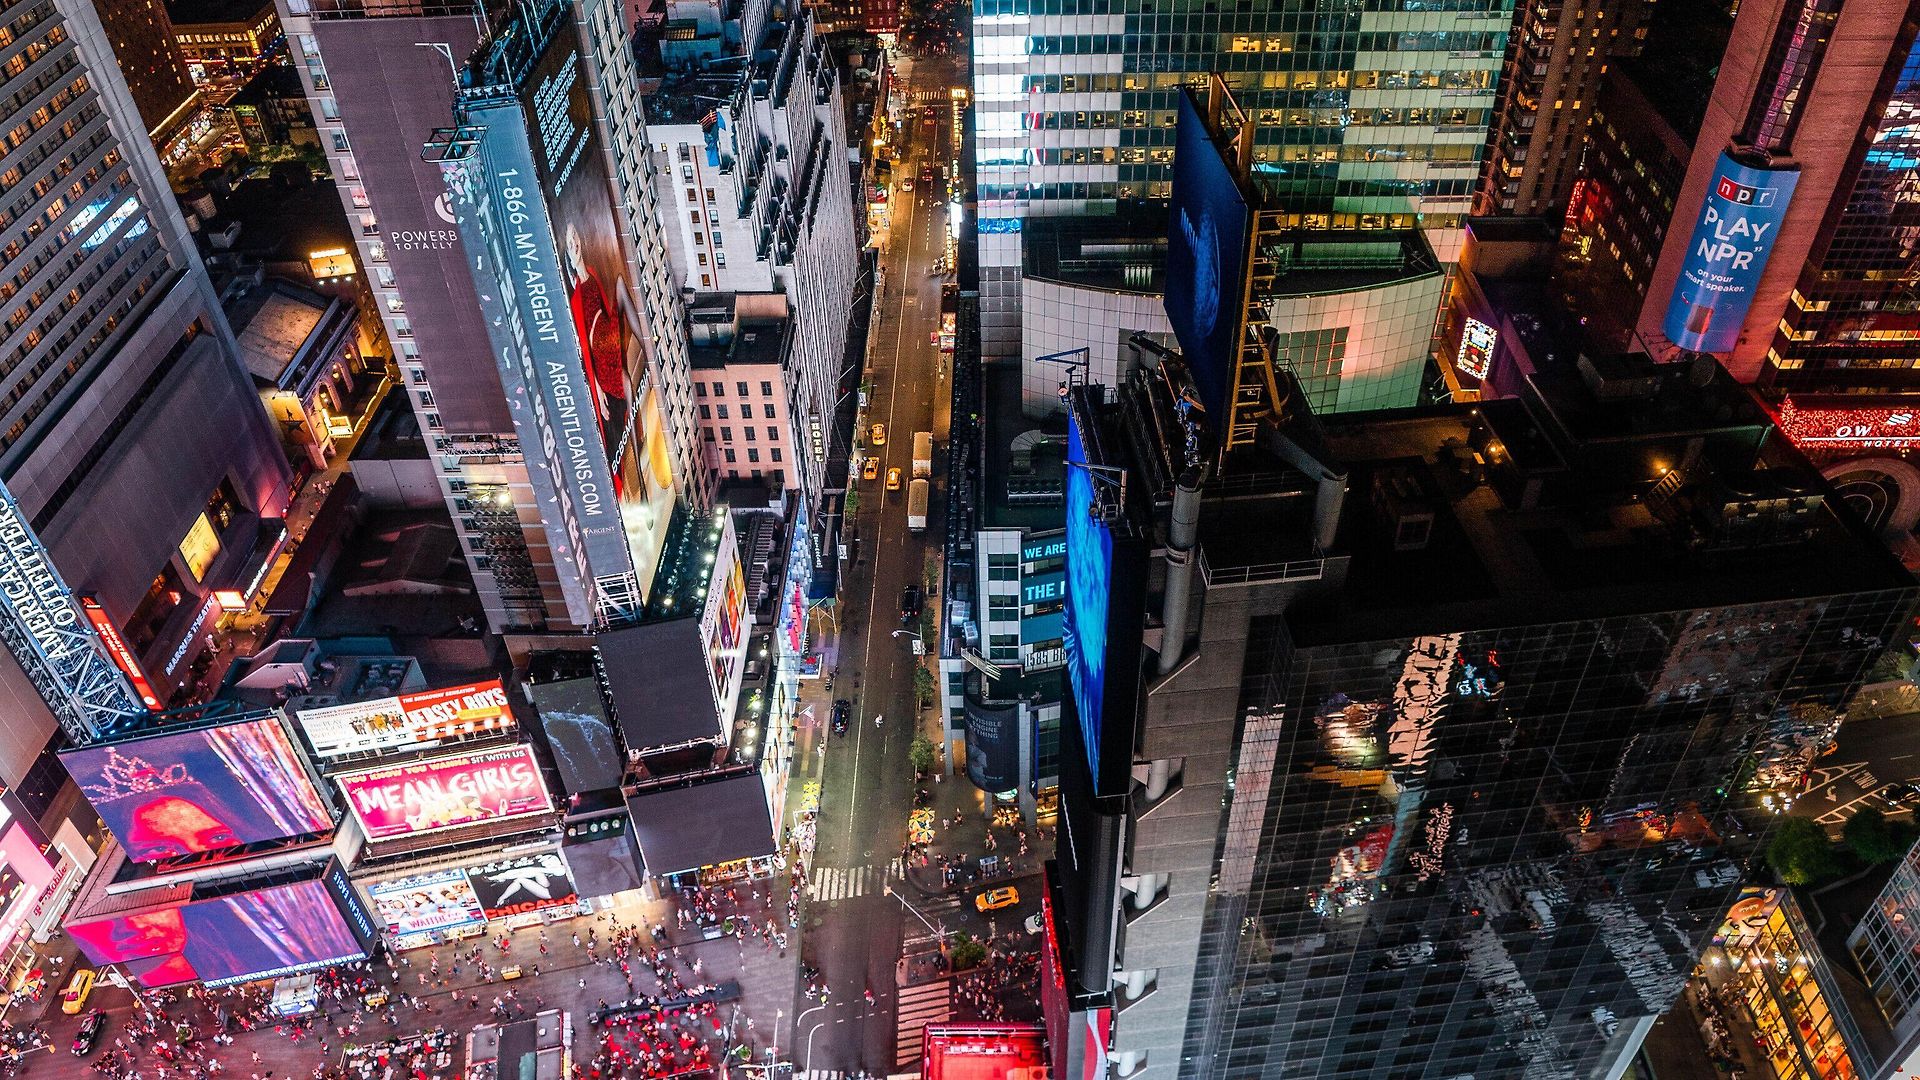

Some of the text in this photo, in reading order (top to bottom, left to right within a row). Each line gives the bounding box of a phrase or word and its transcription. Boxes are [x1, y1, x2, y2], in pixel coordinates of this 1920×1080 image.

[395, 242, 452, 250] TOTALLY
[499, 168, 560, 343] 1-866-MY-ARGENT
[1697, 269, 1734, 283] on your
[1706, 282, 1745, 293] speaker.
[546, 361, 603, 516] ARGENTLOANS.COM
[811, 422, 824, 462] HOTEL
[1024, 542, 1067, 559] WE ARE
[1025, 582, 1056, 601] THE
[165, 630, 194, 676] MARQUIS
[1026, 651, 1048, 666] 1585
[403, 699, 463, 729] JERSEY
[462, 687, 508, 709] BOYS
[471, 756, 484, 764] SIT
[486, 753, 511, 762] WITH
[356, 763, 533, 814] MEAN GIRLS
[333, 871, 372, 938] AMERICAN EAGLE
